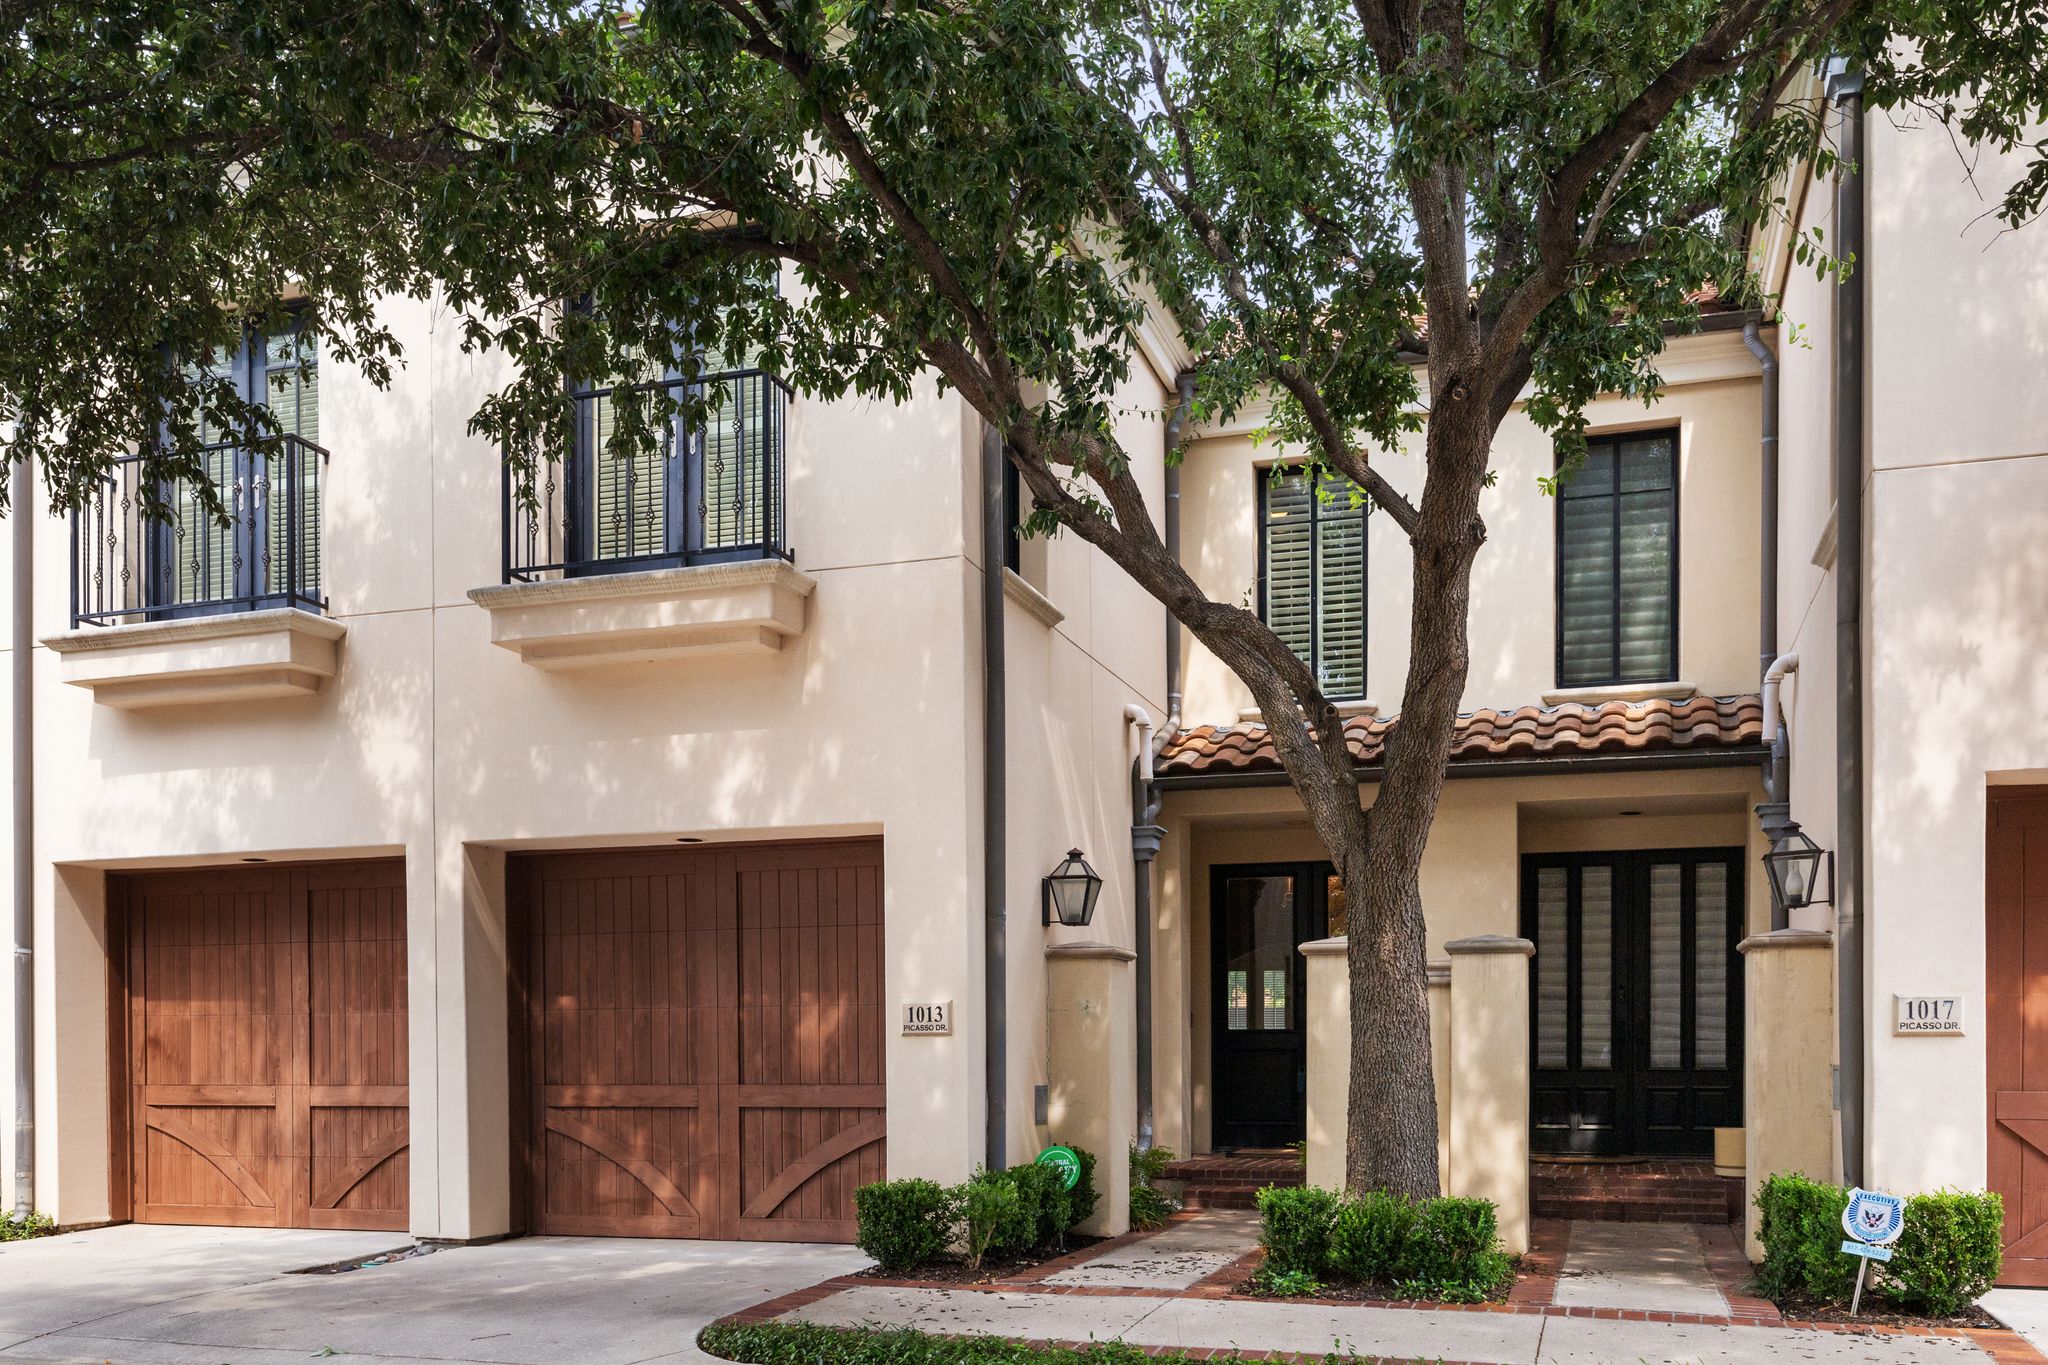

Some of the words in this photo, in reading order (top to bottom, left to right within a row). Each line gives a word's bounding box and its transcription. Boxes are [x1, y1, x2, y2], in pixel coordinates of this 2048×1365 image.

[908, 1005, 943, 1023] 1013
[1905, 999, 1955, 1020] 1017
[903, 1024, 935, 1032] PICASSO
[935, 1024, 948, 1032] DR.
[1899, 1021, 1942, 1030] PICASSO
[1944, 1021, 1961, 1030] DR.
[1859, 1193, 1896, 1205] EXECUTIVE
